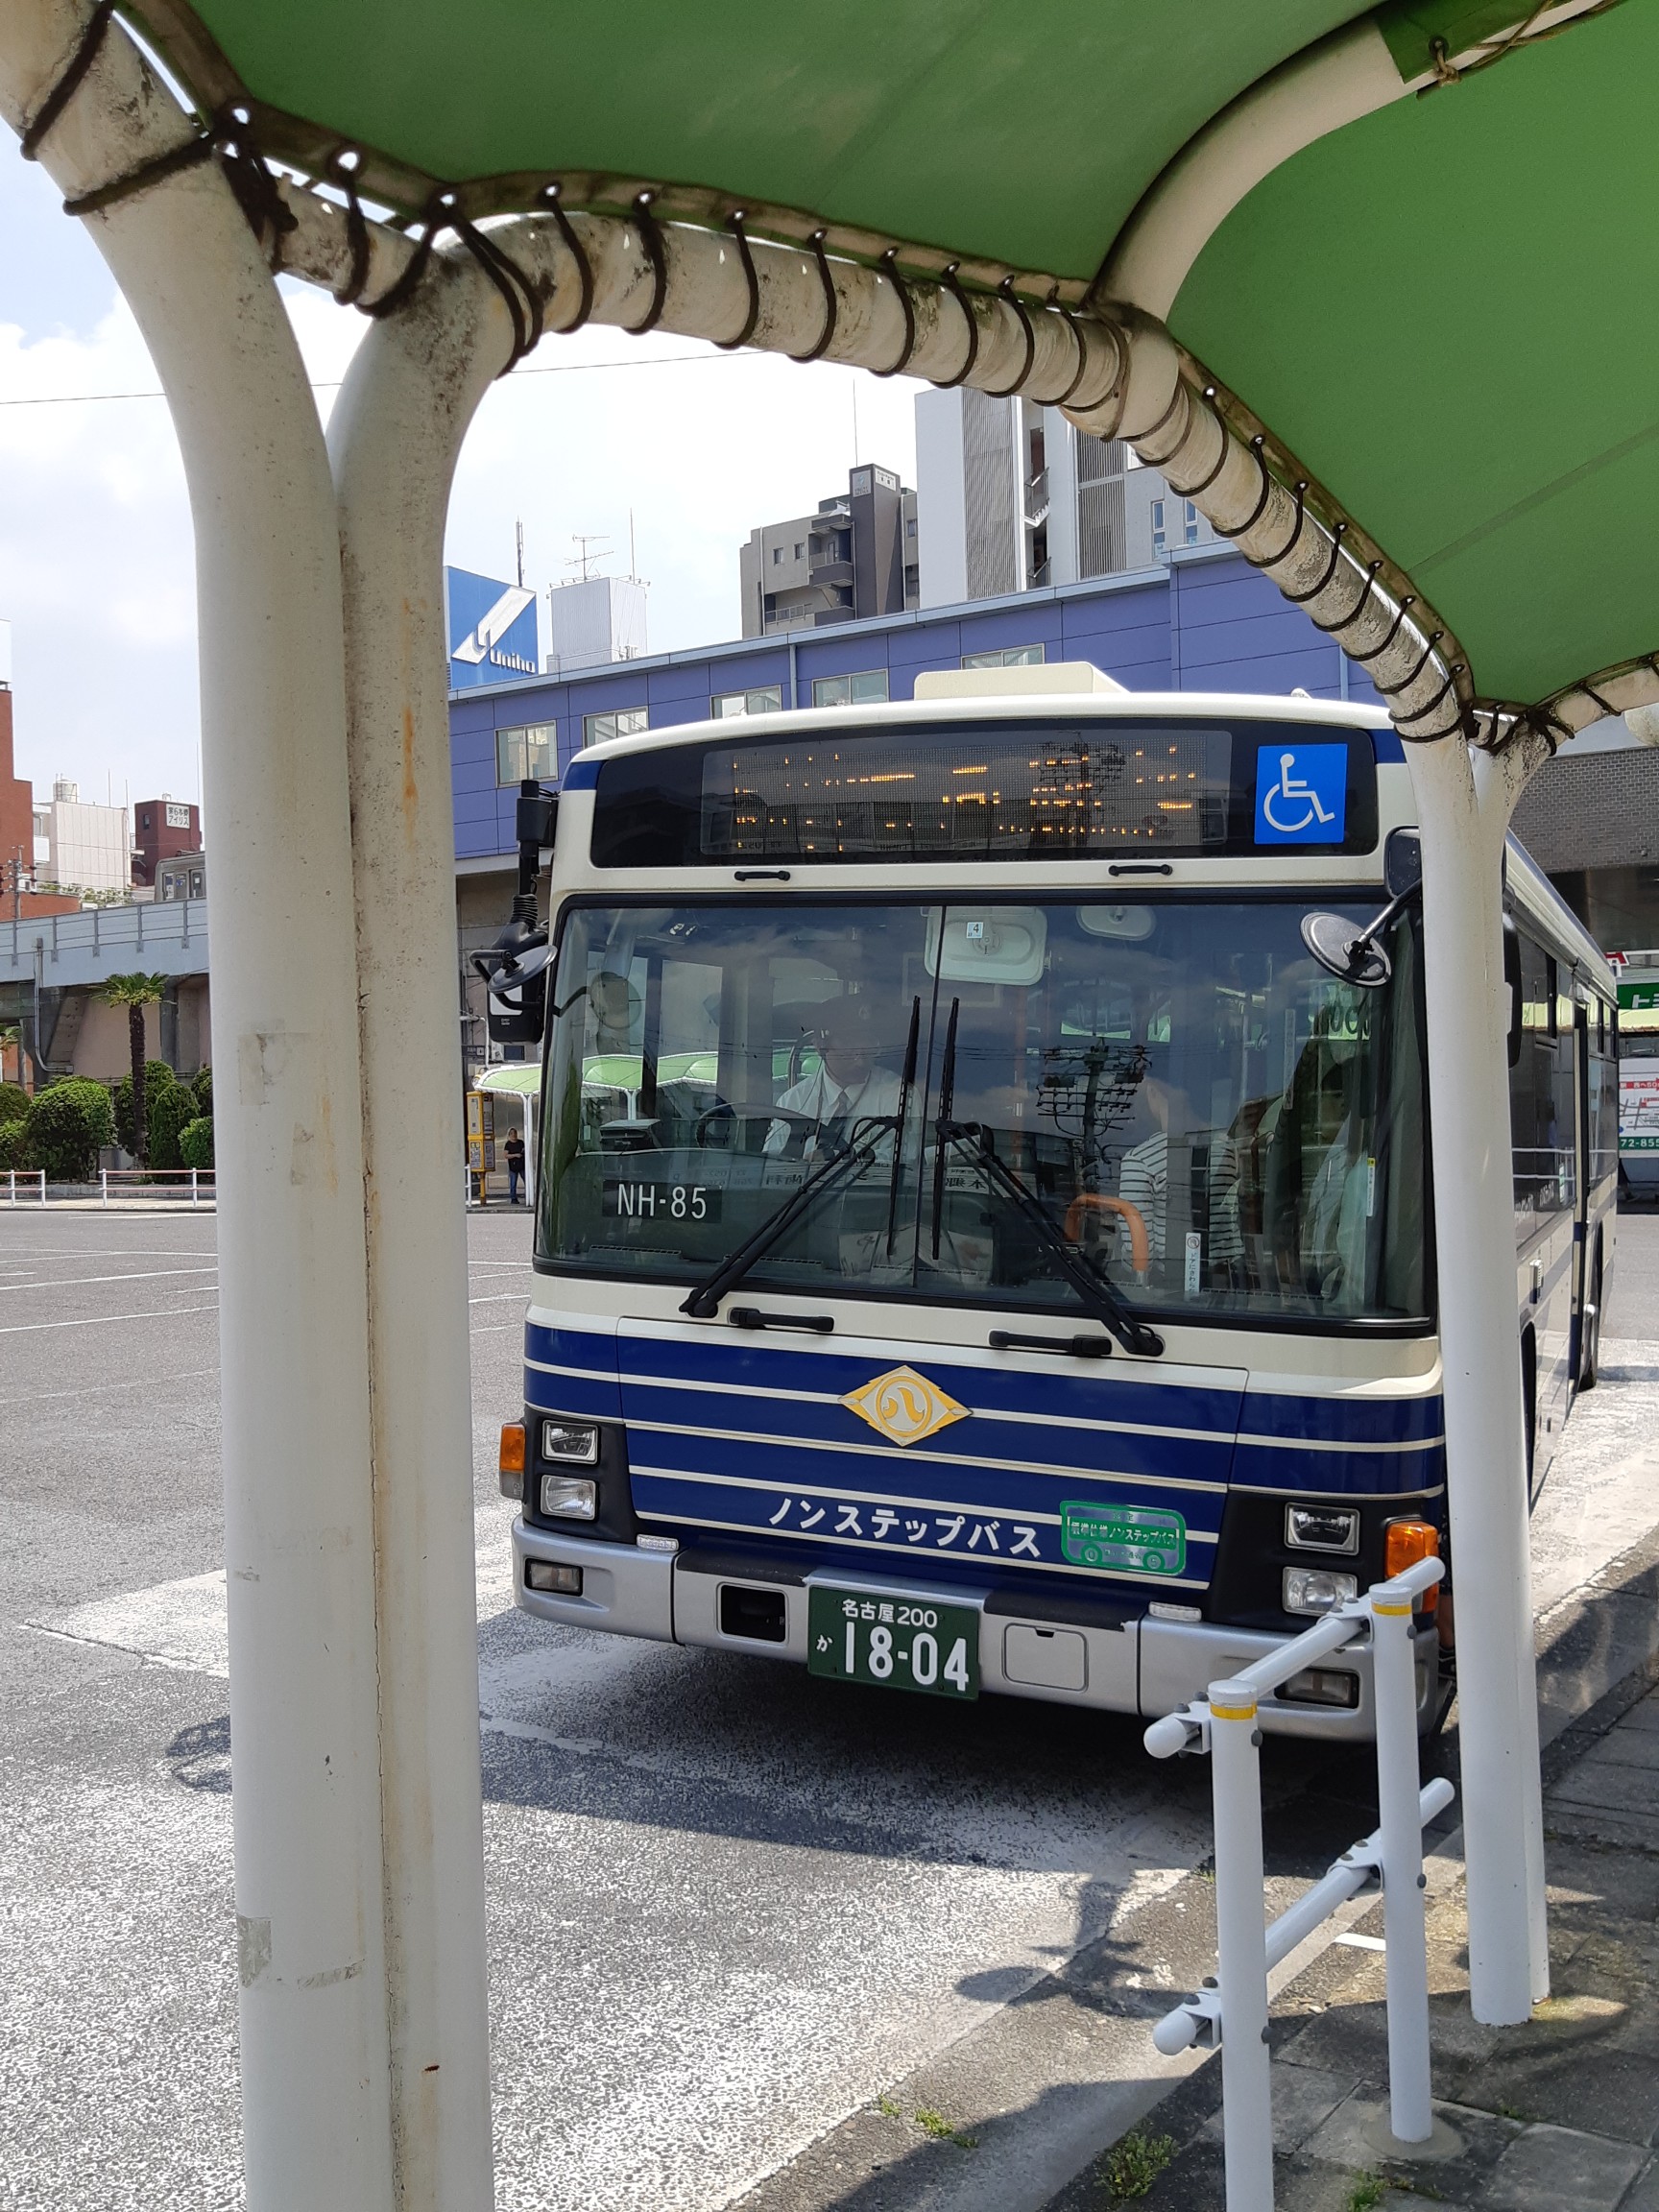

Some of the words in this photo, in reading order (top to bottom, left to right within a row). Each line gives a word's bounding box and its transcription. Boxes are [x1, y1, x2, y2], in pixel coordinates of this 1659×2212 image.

[490, 648, 536, 673] Uniho
[168, 816, 189, 826] アイリス
[973, 924, 979, 933] 4
[617, 1184, 707, 1219] NH-85
[768, 1498, 1042, 1557] ノンステップバス
[816, 1634, 833, 1652] か
[845, 1621, 970, 1692] 18-04
